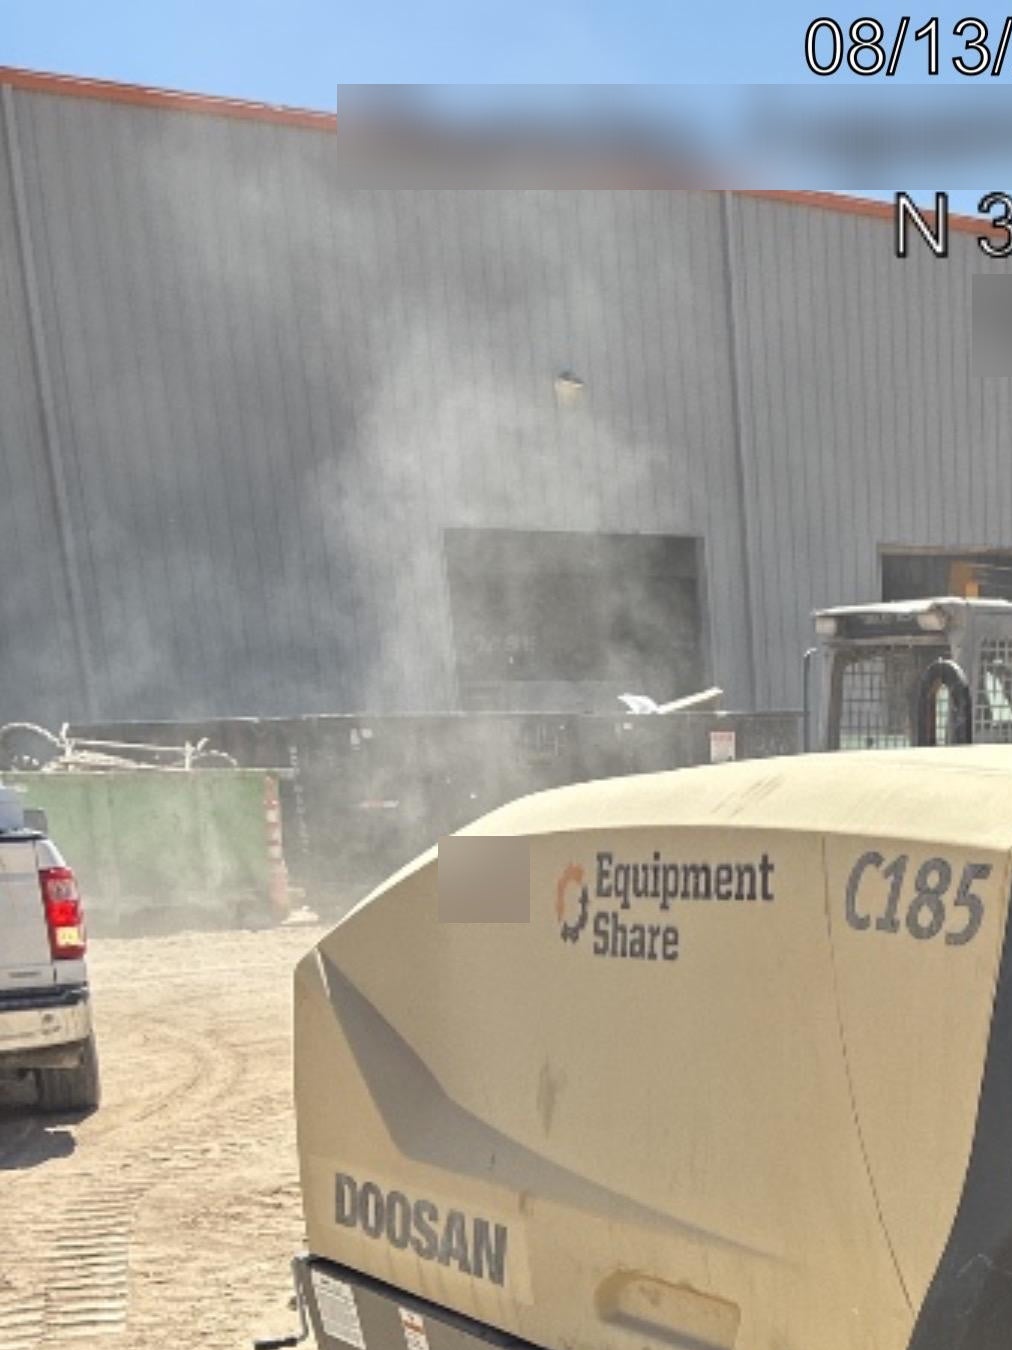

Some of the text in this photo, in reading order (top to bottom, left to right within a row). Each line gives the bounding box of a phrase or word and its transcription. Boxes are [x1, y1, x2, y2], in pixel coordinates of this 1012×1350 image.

[596, 851, 775, 911] Equipment
[845, 850, 992, 946] C185
[592, 911, 680, 961] Share
[335, 1172, 508, 1288] DOOSAN
